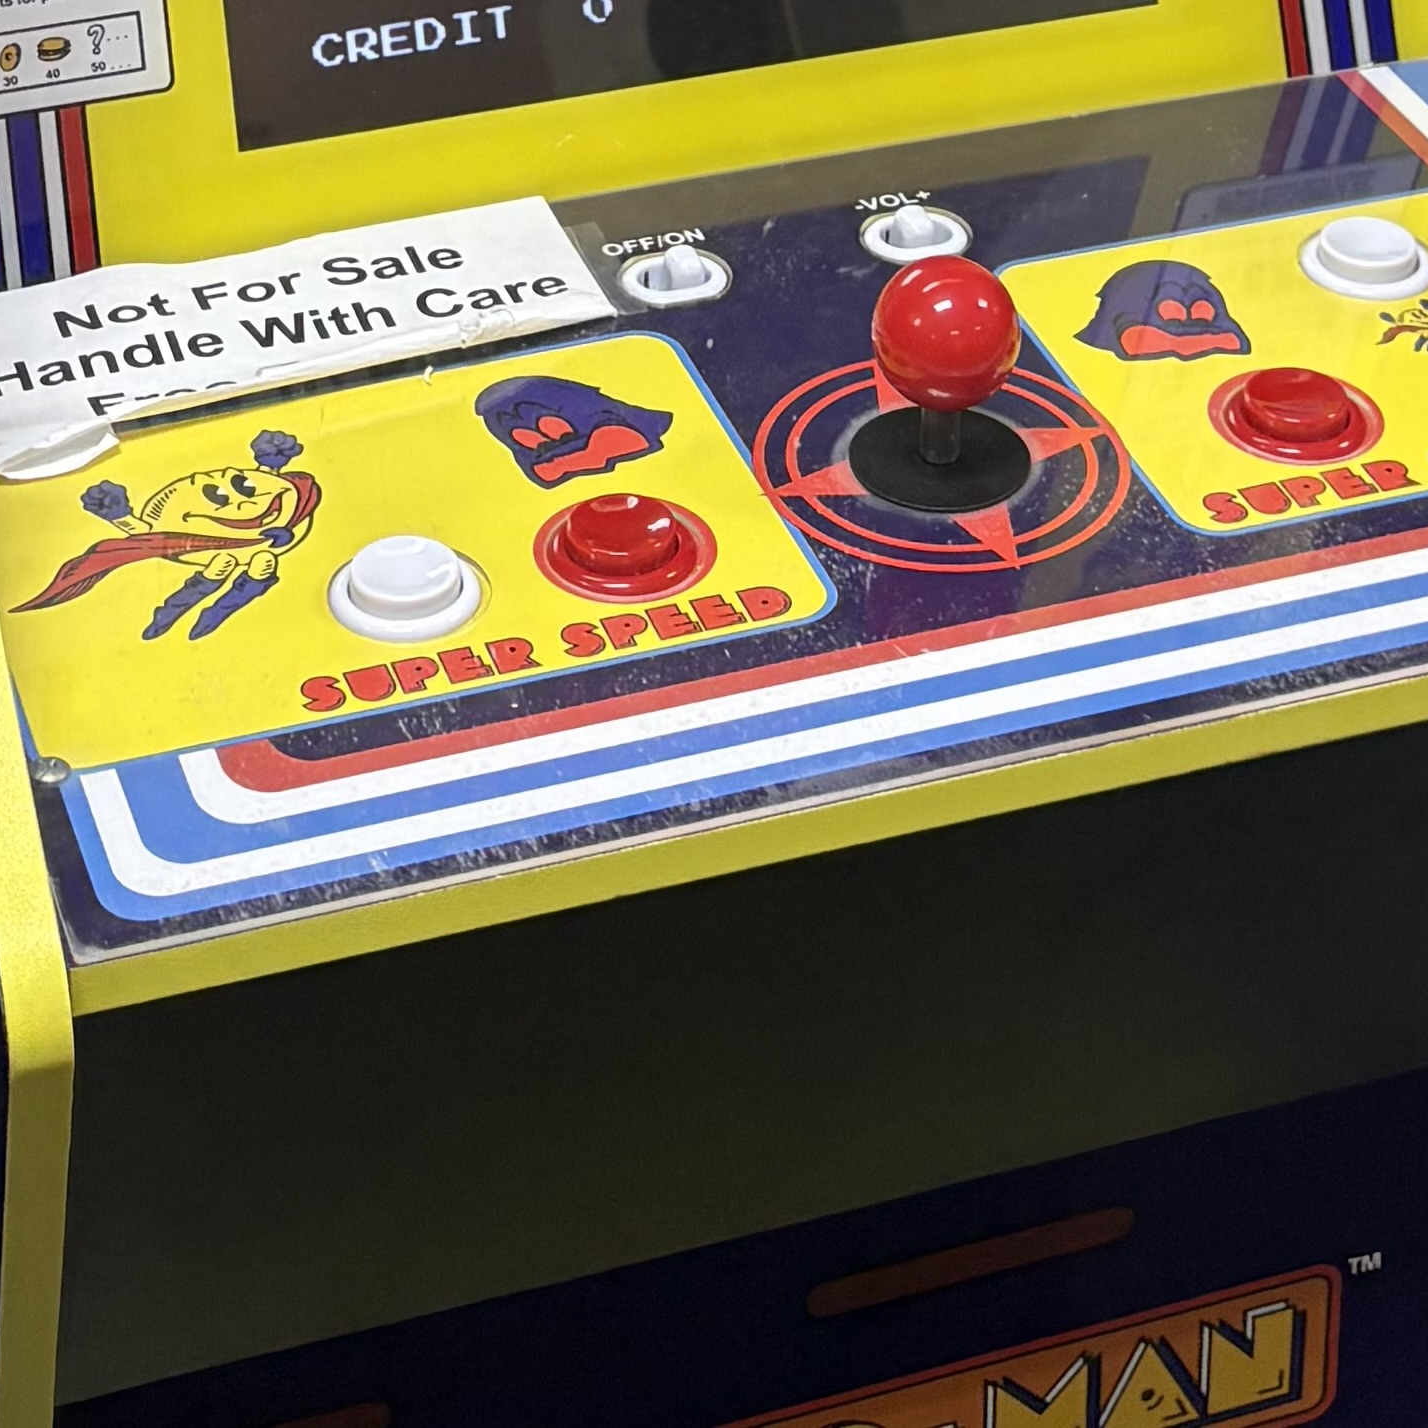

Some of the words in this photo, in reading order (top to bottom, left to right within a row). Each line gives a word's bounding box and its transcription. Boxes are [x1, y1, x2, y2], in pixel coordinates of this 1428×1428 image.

[310, 3, 515, 69] CREDIT
[601, 226, 706, 259] OFF/ON
[52, 291, 176, 339] Not
[190, 268, 305, 312] For
[326, 240, 465, 288] Sale
[248, 295, 397, 351] With
[413, 270, 570, 321] Care
[1202, 457, 1410, 526] SUPER
[299, 630, 542, 712] SUPER
[560, 584, 794, 660] SPEED
